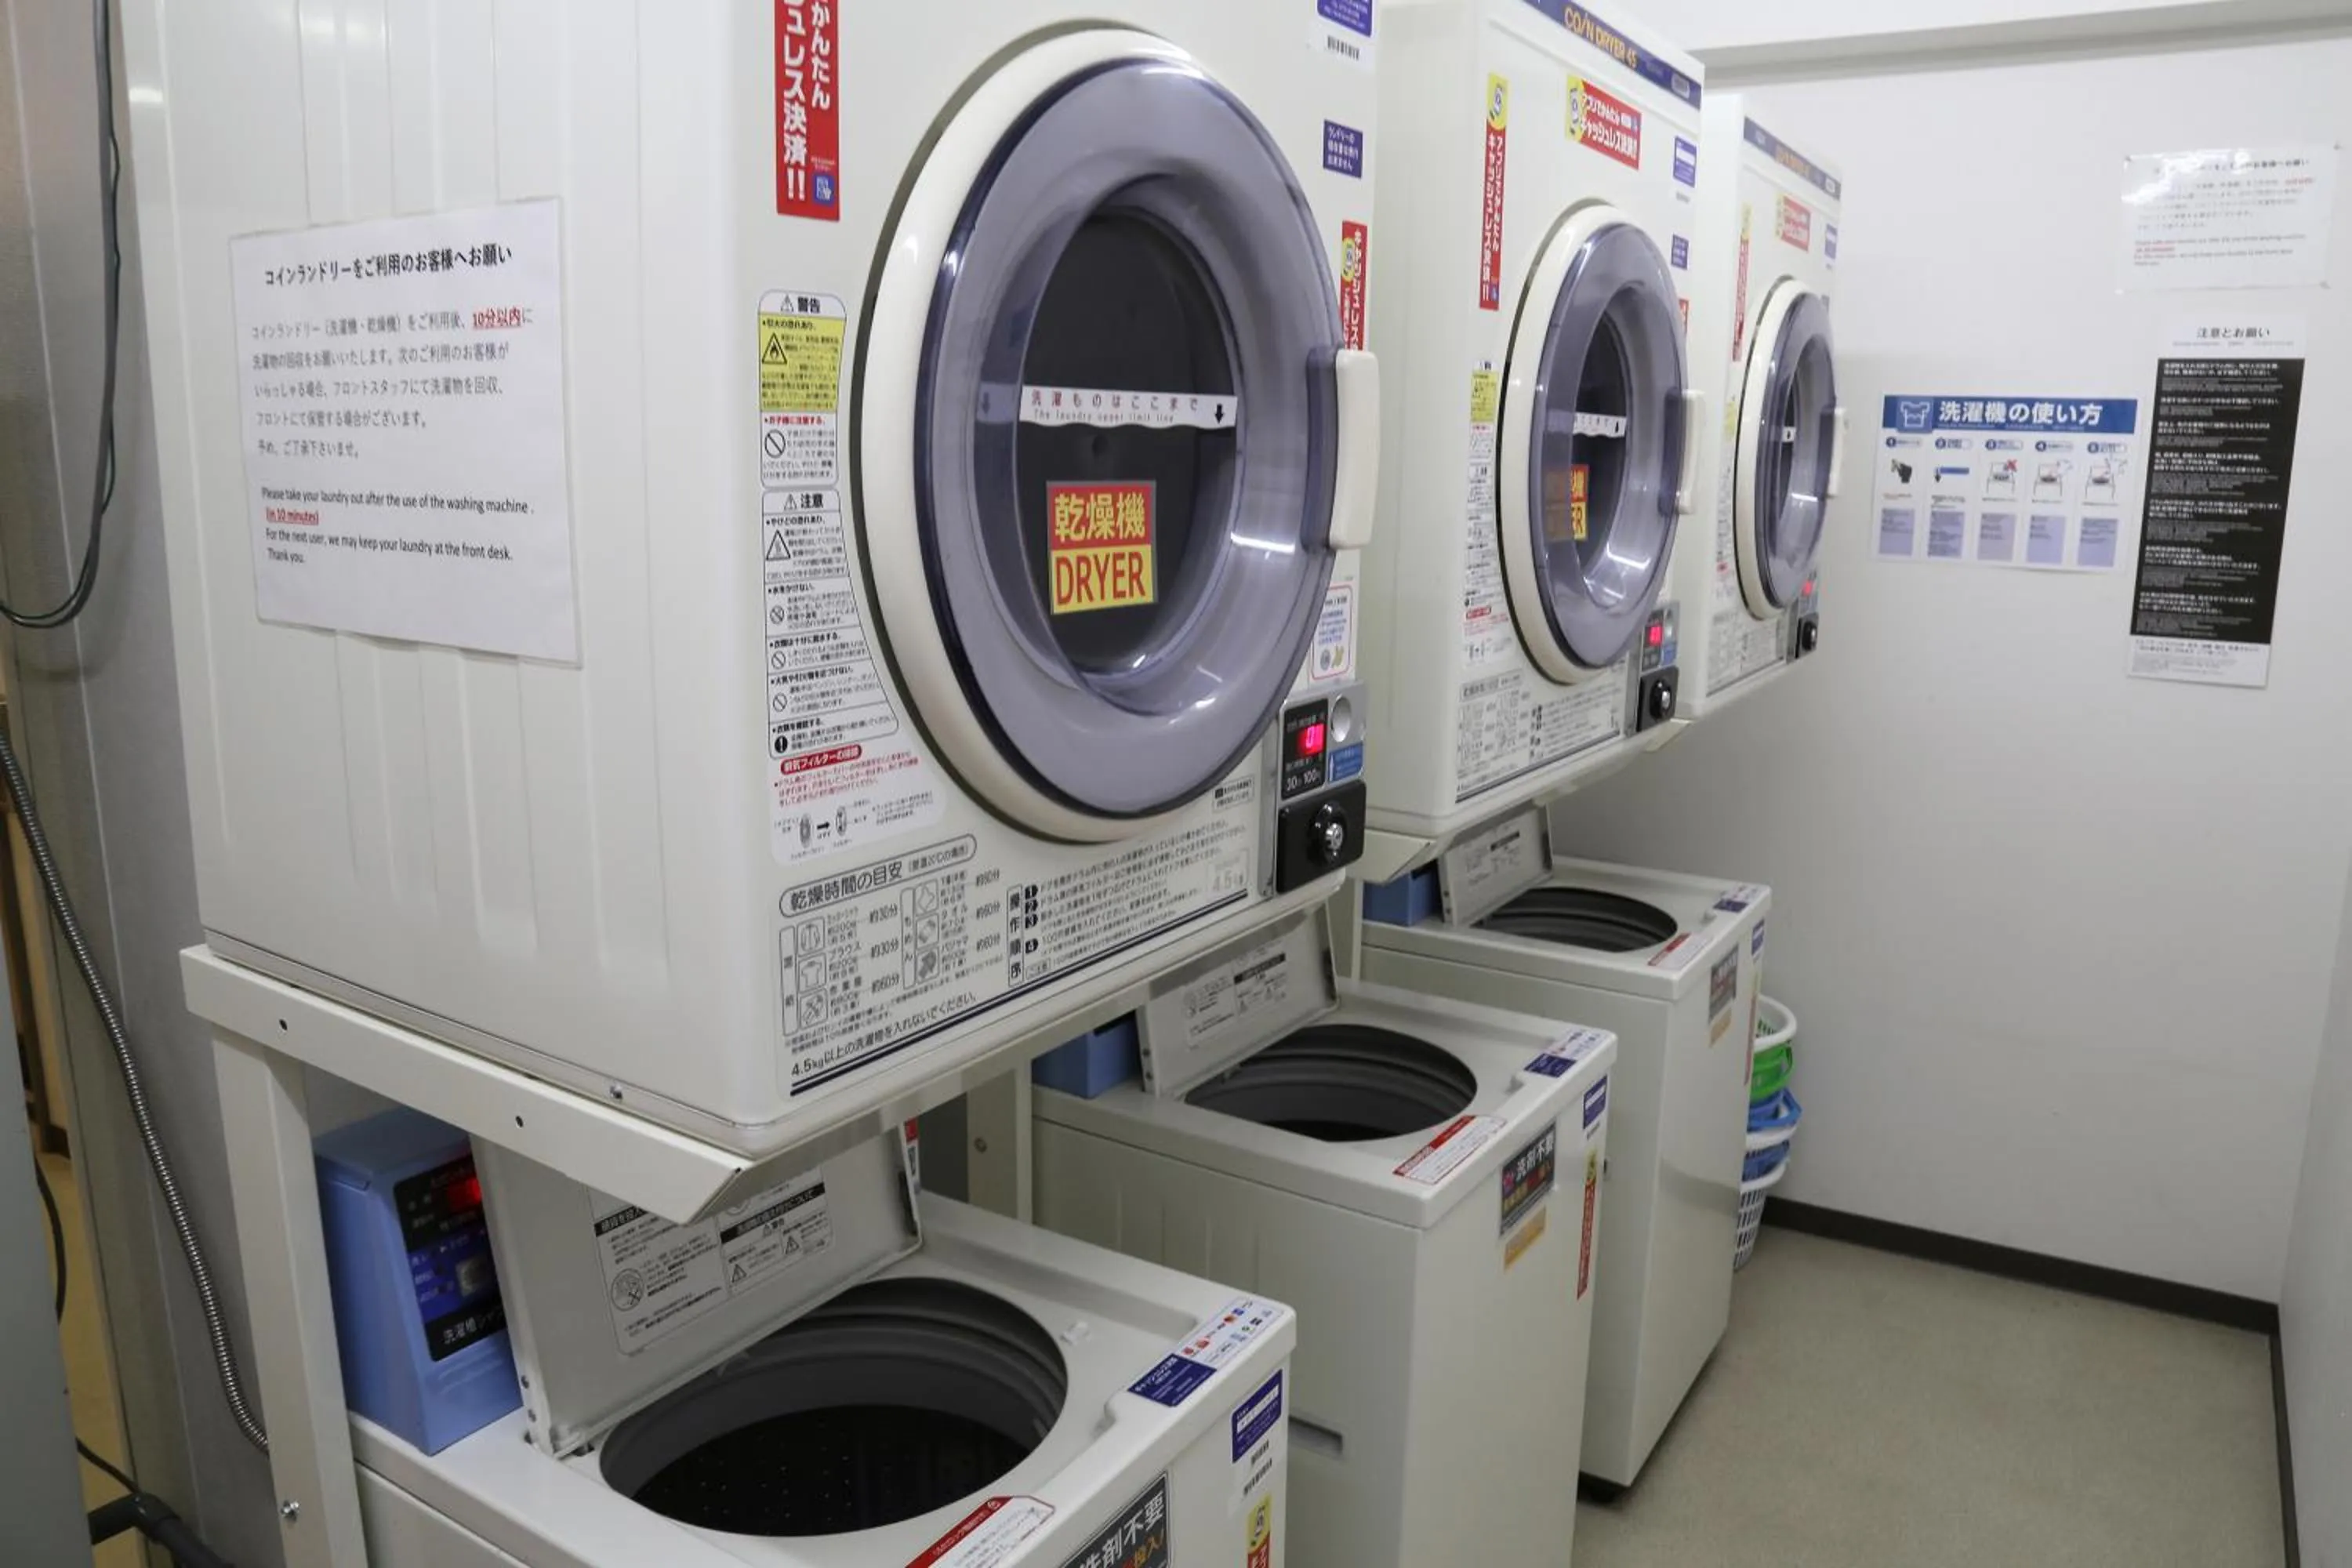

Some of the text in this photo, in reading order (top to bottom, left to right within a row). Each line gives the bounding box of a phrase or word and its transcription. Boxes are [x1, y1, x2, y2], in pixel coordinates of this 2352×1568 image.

[265, 242, 513, 286] コインランドリーをご利用のお客様へお願い
[1032, 389, 1198, 410] 洗濯ものはここまで
[1939, 401, 2103, 426] 洗濯機の使い方
[261, 486, 284, 500] Please
[285, 488, 301, 500] take
[303, 492, 318, 503] your
[321, 490, 348, 506] laundry
[350, 493, 364, 504] out
[366, 492, 385, 506] after
[387, 494, 401, 506] the
[402, 496, 417, 507] use
[419, 495, 428, 508] of
[430, 495, 445, 509] the
[447, 496, 485, 514] washing
[486, 498, 528, 514] machine
[800, 493, 823, 509] 注意
[277, 508, 285, 521] 10
[1054, 492, 1145, 543] 乾燥機
[266, 528, 277, 540] For
[279, 529, 290, 541] the
[292, 532, 307, 543] next
[328, 536, 339, 546] we
[342, 536, 357, 552] may
[359, 535, 378, 551] keep
[379, 539, 397, 553] your
[400, 538, 432, 557] laundry
[435, 543, 443, 555] at
[445, 542, 459, 557] the
[463, 543, 485, 558] front
[488, 545, 513, 561] desk.
[268, 547, 289, 561] Thank
[1056, 551, 1146, 606] DRYER
[791, 862, 902, 910] 乾燥時間の目安
